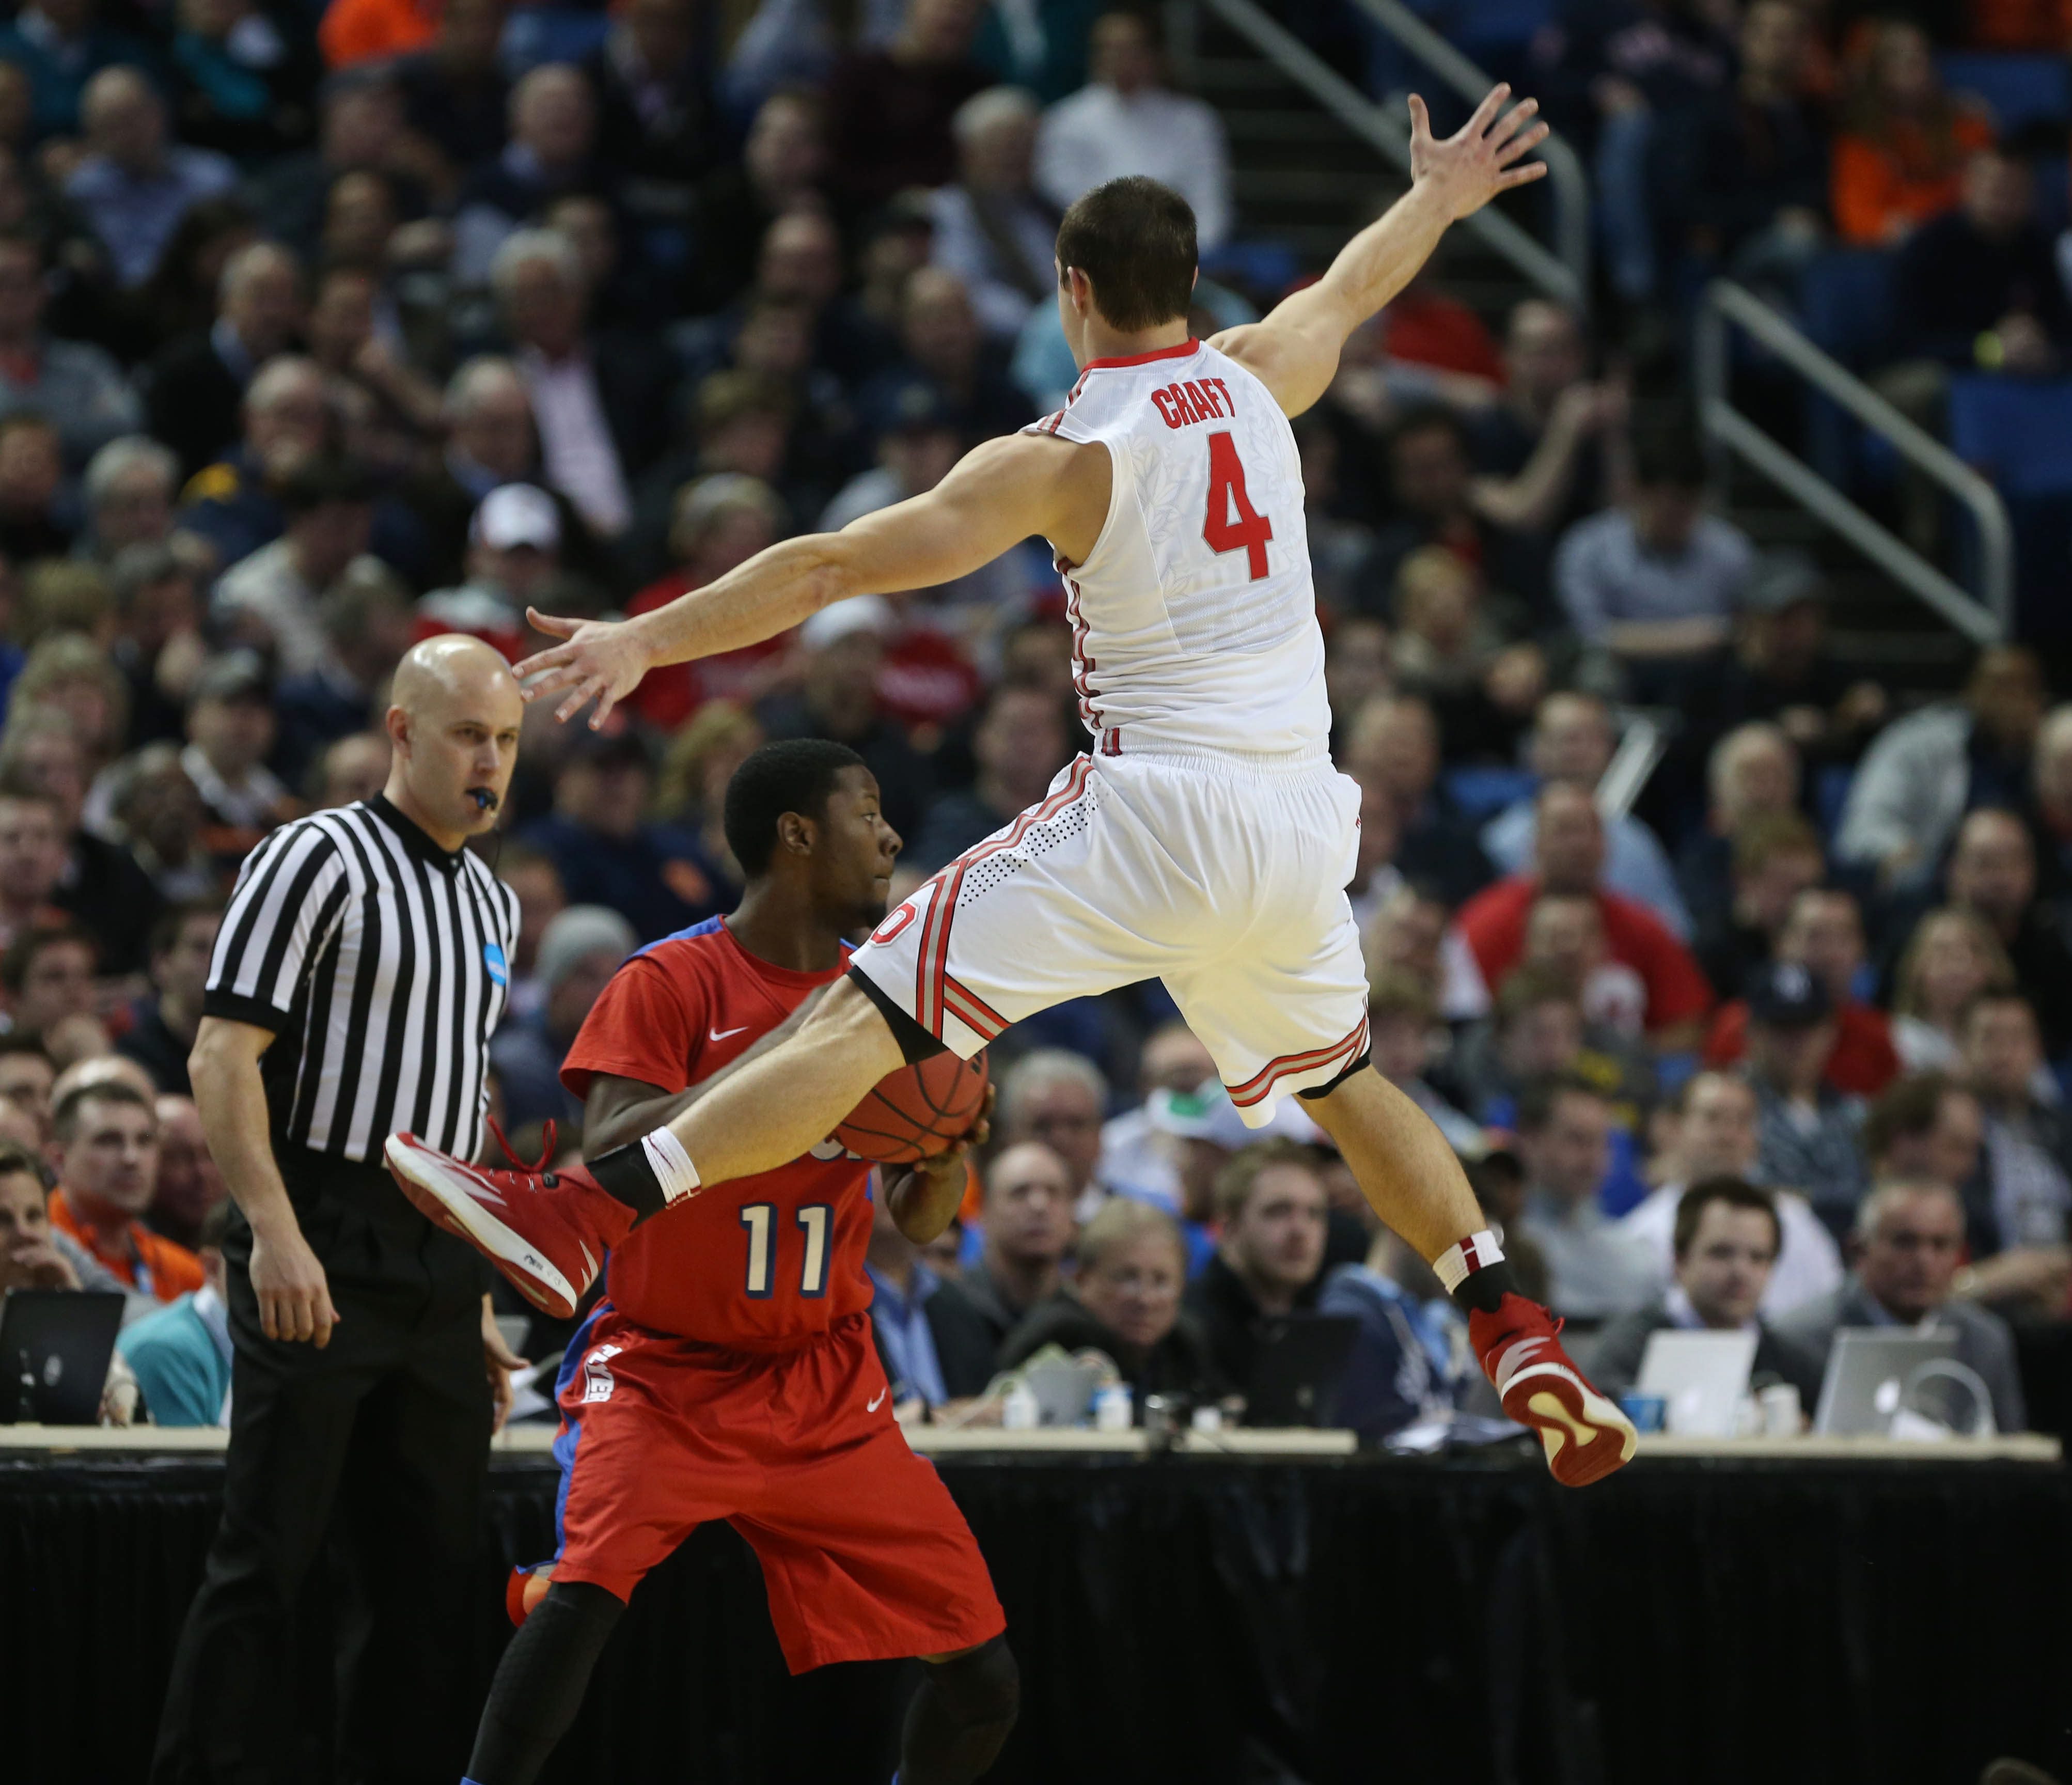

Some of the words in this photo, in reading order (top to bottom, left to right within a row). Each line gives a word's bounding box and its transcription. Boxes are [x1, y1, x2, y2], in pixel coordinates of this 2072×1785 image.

[1151, 378, 1235, 430] CRAFT
[1201, 429, 1274, 583] 4
[739, 1201, 835, 1300] 11
